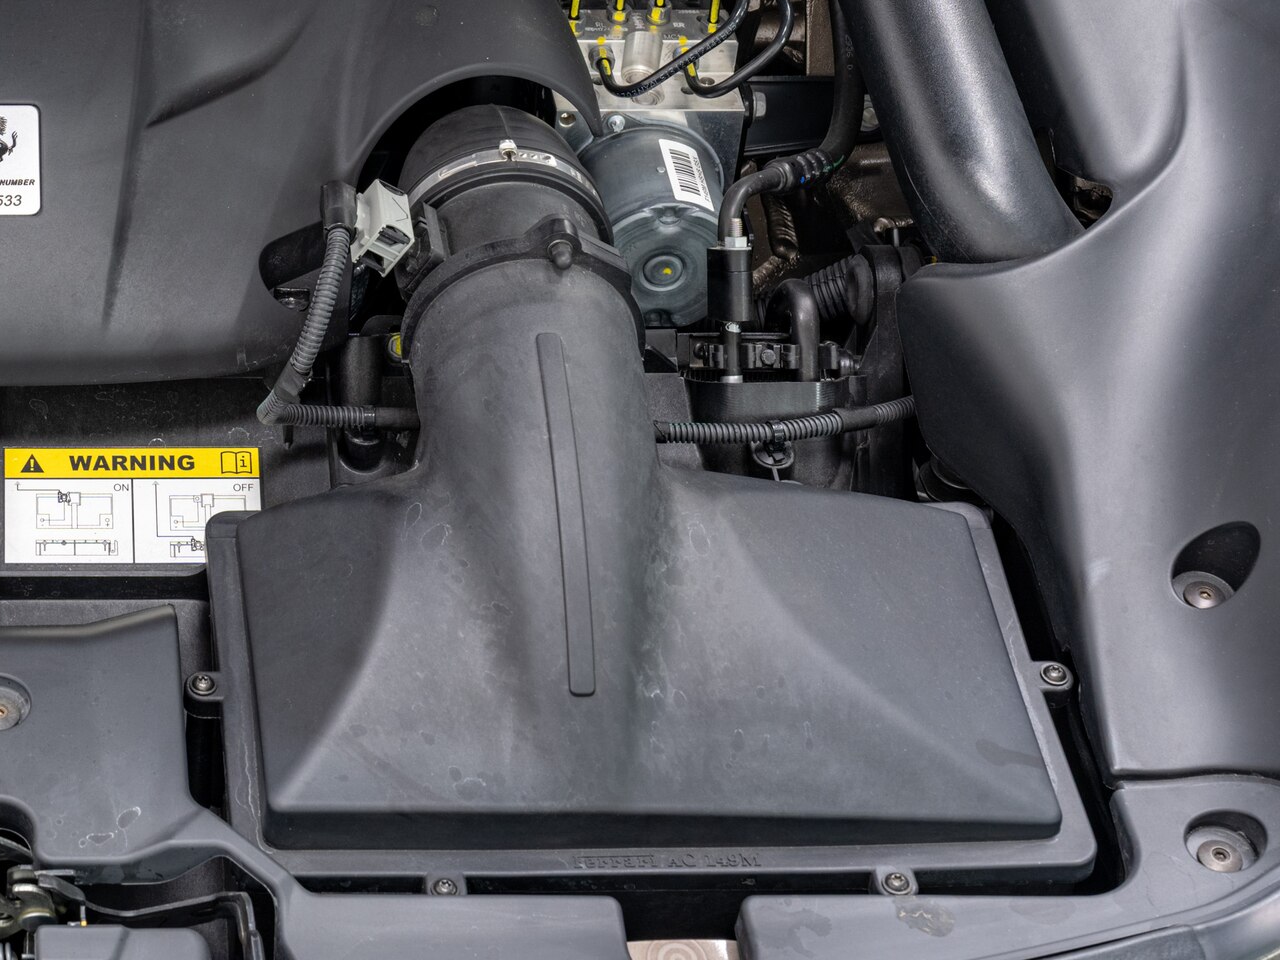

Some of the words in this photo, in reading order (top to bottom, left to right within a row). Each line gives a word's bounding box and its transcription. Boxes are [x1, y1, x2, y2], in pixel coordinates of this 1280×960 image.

[69, 455, 195, 471] WARNING
[113, 483, 130, 492] ON
[233, 483, 254, 492] OFF
[572, 854, 658, 869] Ferrari
[667, 854, 697, 868] AC
[704, 853, 762, 868] 149M
